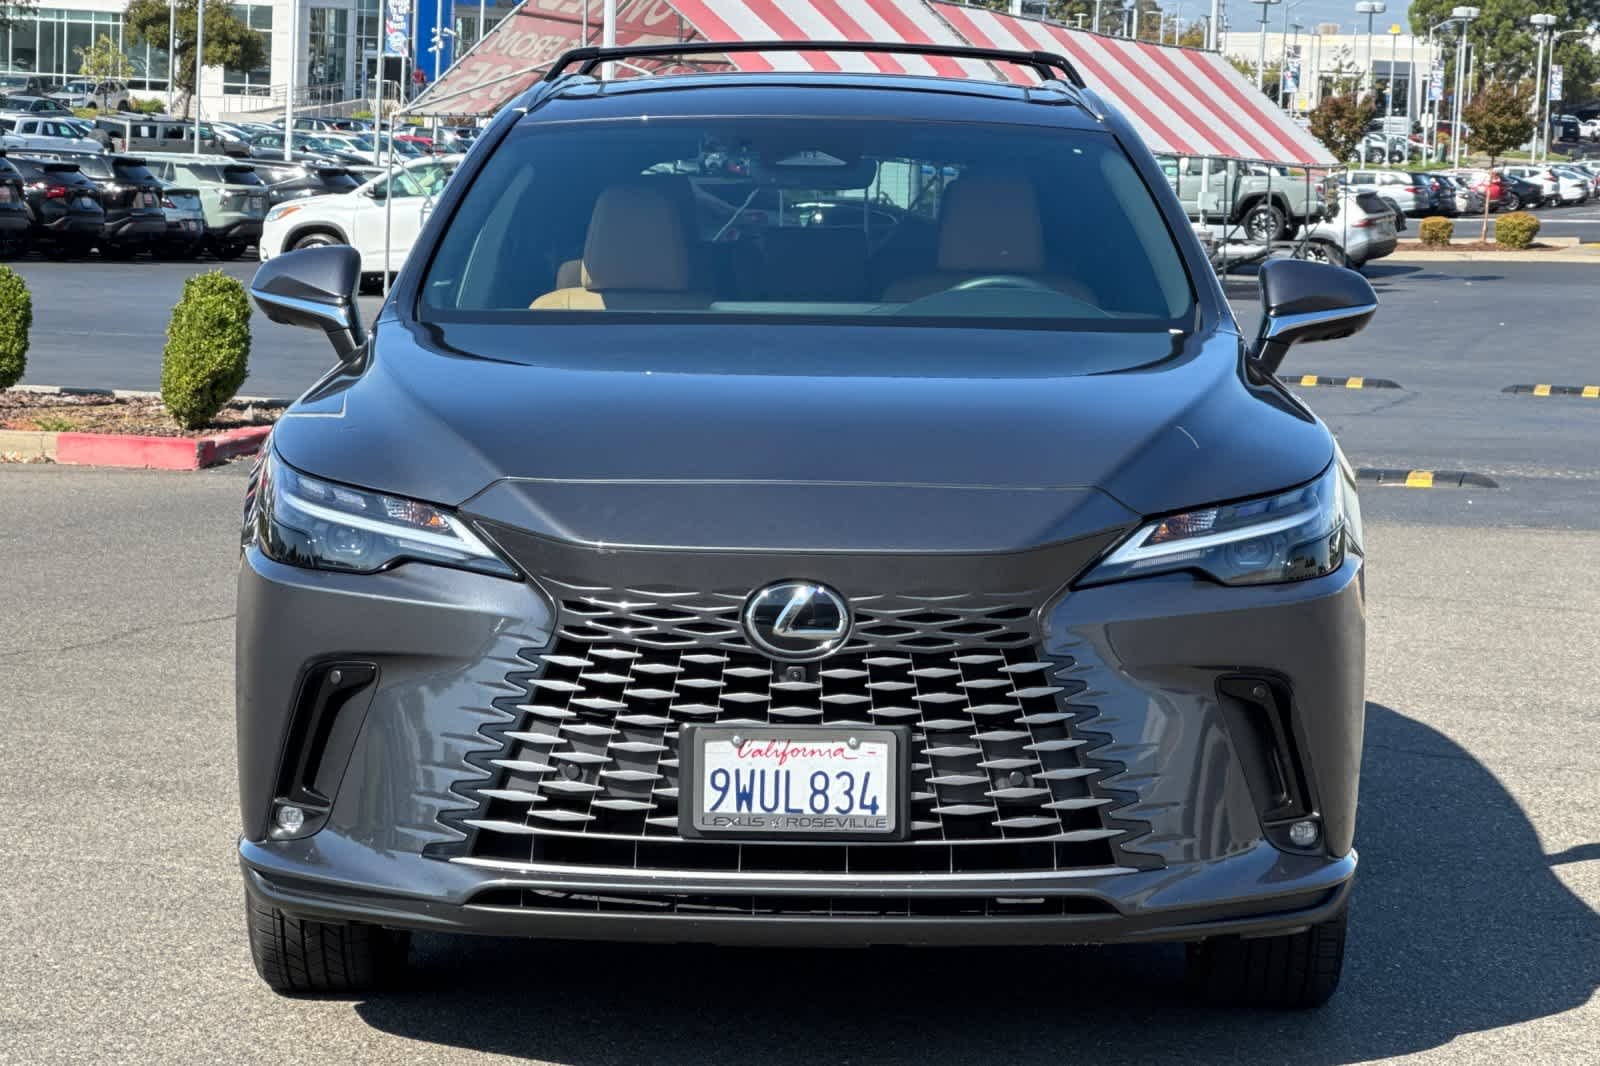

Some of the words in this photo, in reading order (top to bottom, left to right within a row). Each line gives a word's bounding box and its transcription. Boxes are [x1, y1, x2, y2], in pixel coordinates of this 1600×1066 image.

[736, 739, 858, 766] California
[709, 768, 879, 815] 9WUL834
[701, 816, 765, 828] LEXUS
[786, 817, 888, 829] ROSEVILLE
